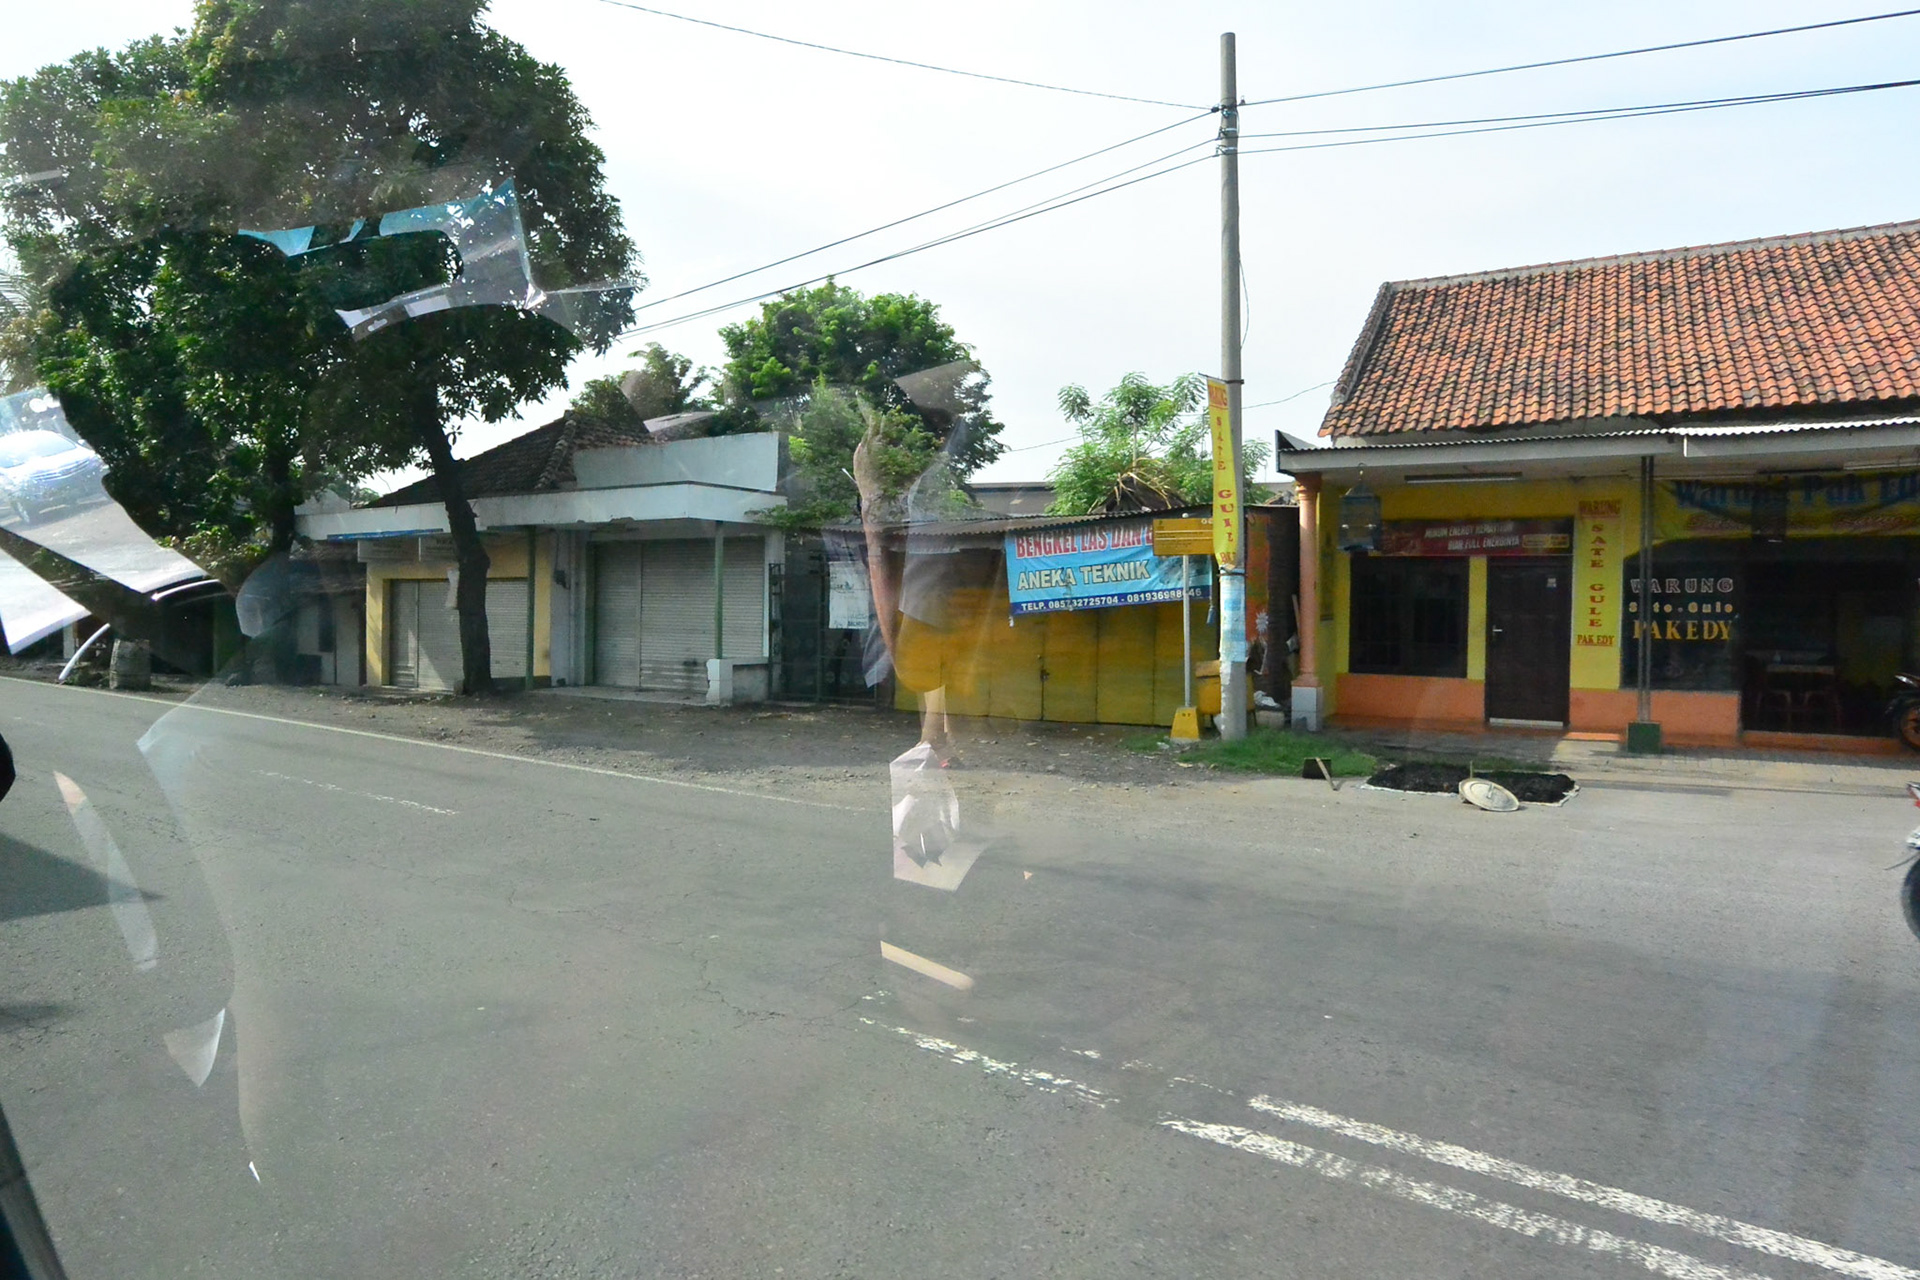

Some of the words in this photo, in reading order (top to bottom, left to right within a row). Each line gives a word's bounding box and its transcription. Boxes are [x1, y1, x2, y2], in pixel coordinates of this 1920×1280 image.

[1579, 500, 1621, 515] WARUNG
[1015, 530, 1077, 559] BENGKEL
[1081, 527, 1108, 554] LAS
[1111, 525, 1142, 549] DAN
[1590, 523, 1606, 568] SATE
[1017, 566, 1077, 591] ANEKA
[1080, 560, 1151, 584] TEKNIK
[1630, 577, 1734, 594] WARUNG
[1021, 602, 1046, 611] TELP.
[1127, 588, 1202, 602] 08193699846
[1588, 583, 1605, 628] GULE
[1628, 601, 1672, 614] Ste
[1577, 634, 1594, 646] PAK
[1596, 634, 1615, 646] EDY
